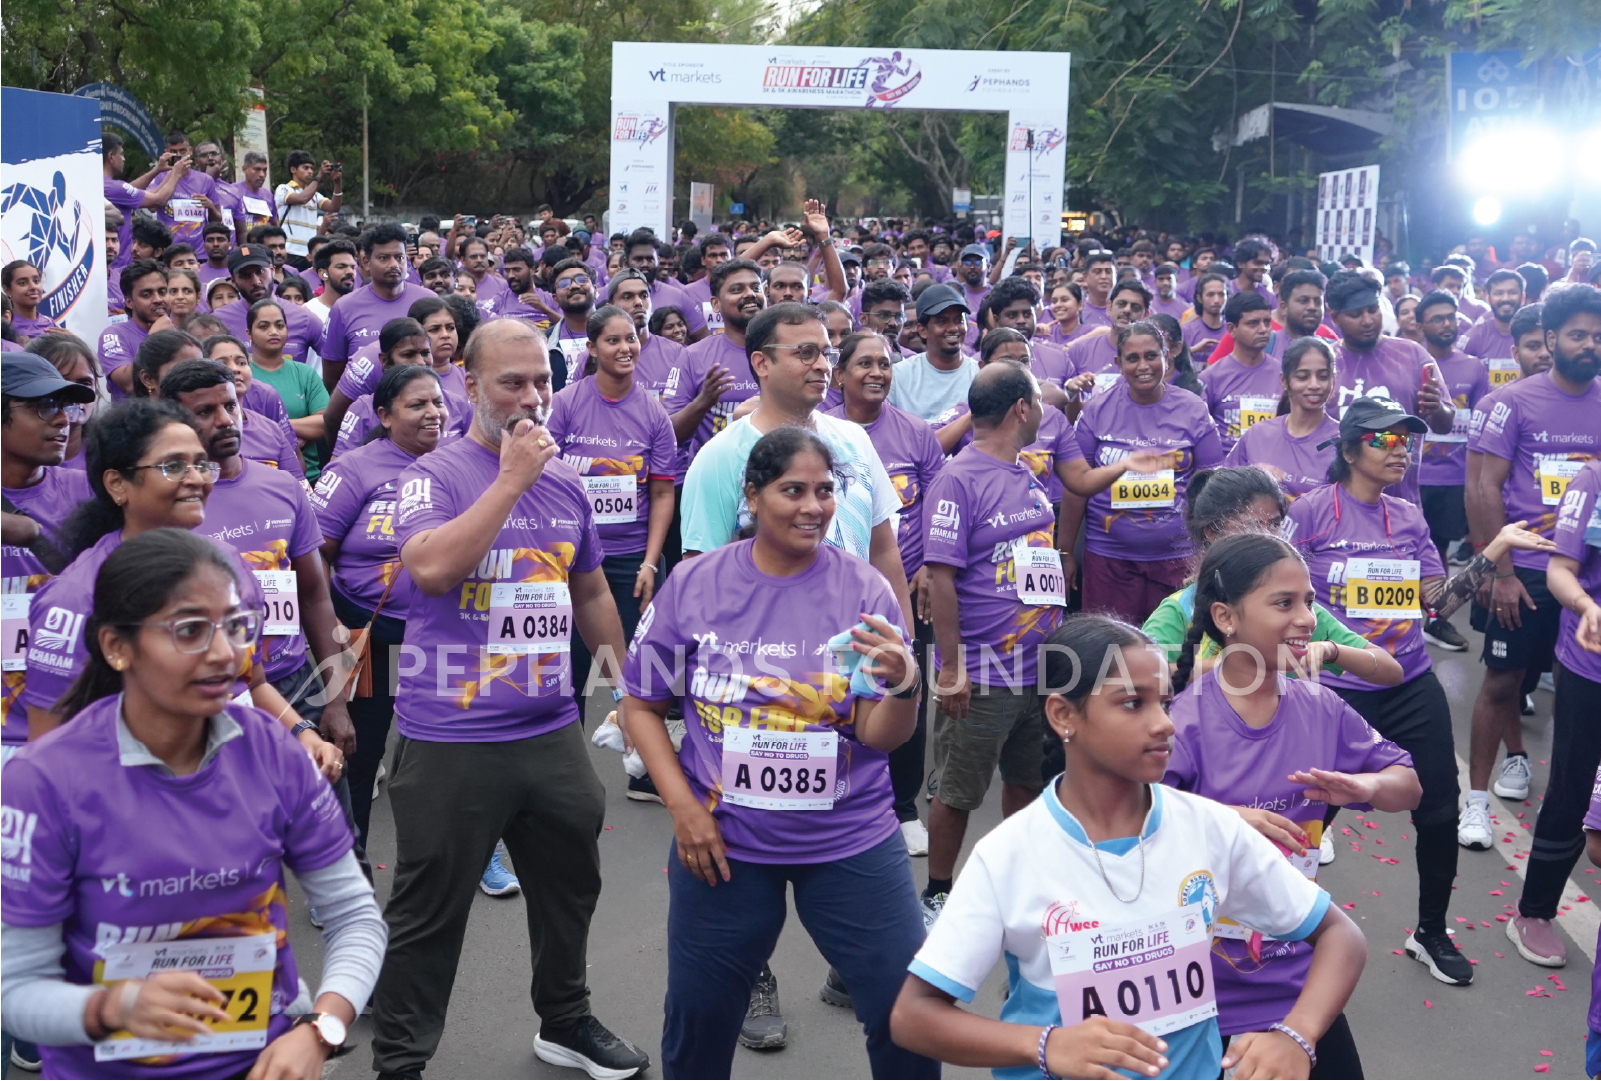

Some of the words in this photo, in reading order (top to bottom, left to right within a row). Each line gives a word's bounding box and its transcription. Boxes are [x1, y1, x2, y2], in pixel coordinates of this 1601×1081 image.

[649, 68, 667, 82] vt
[670, 70, 722, 84] markets
[765, 67, 800, 87] RUN
[800, 68, 832, 88] FOR
[832, 68, 867, 88] LIFE
[983, 78, 1030, 87] PEPHANDS
[49, 263, 89, 318] FINISHER
[730, 379, 758, 391] marke
[1504, 373, 1517, 382] 00
[576, 435, 617, 448] markets
[1533, 430, 1549, 443] vt
[1552, 432, 1594, 444] markets
[1119, 485, 1128, 499] B
[1133, 484, 1169, 498] 0034
[1551, 481, 1561, 495] B
[594, 497, 633, 514] 0504
[366, 515, 395, 535] FO
[502, 513, 538, 530] rkets
[987, 512, 1009, 528] vt
[1010, 507, 1042, 524] markets
[929, 527, 958, 541] CHARAM
[468, 549, 514, 580] UN
[995, 558, 1016, 585] FO
[1380, 567, 1391, 575] FOR
[263, 579, 277, 587] LIFE
[1025, 573, 1036, 592] A
[1040, 573, 1063, 593] 0017
[459, 582, 492, 611] FO
[515, 593, 530, 601] RUN
[530, 593, 543, 601] FOR
[543, 592, 556, 601] LIFE
[1357, 586, 1369, 605] B
[1374, 587, 1415, 606] 0209
[263, 600, 294, 621] 010
[459, 612, 471, 620] 3K
[500, 616, 516, 638] A
[523, 614, 568, 639] 0384
[692, 631, 720, 651] vt
[722, 636, 797, 657] markets
[690, 665, 751, 703] RUN
[751, 741, 770, 750] RUN
[770, 741, 788, 751] FOR
[789, 742, 808, 751] LIFE
[752, 733, 761, 742] vt
[735, 763, 752, 790] A
[761, 766, 827, 794] 0385
[1240, 796, 1287, 811] rkets
[102, 873, 133, 898] vt
[139, 866, 240, 898] markets
[1090, 933, 1104, 945] vt
[1106, 929, 1144, 944] markets
[1093, 942, 1119, 960] RUN
[1121, 937, 1145, 954] FOR
[1147, 930, 1170, 948] LIFE
[151, 956, 179, 970] RUN
[180, 955, 207, 968] FOR
[207, 953, 236, 966] LIFE
[1094, 961, 1113, 972] SAY
[1114, 957, 1129, 968] NO
[1130, 954, 1144, 965] TO
[1144, 947, 1174, 961] DRUGS
[1082, 985, 1108, 1020] A
[1117, 960, 1205, 1016] 0110
